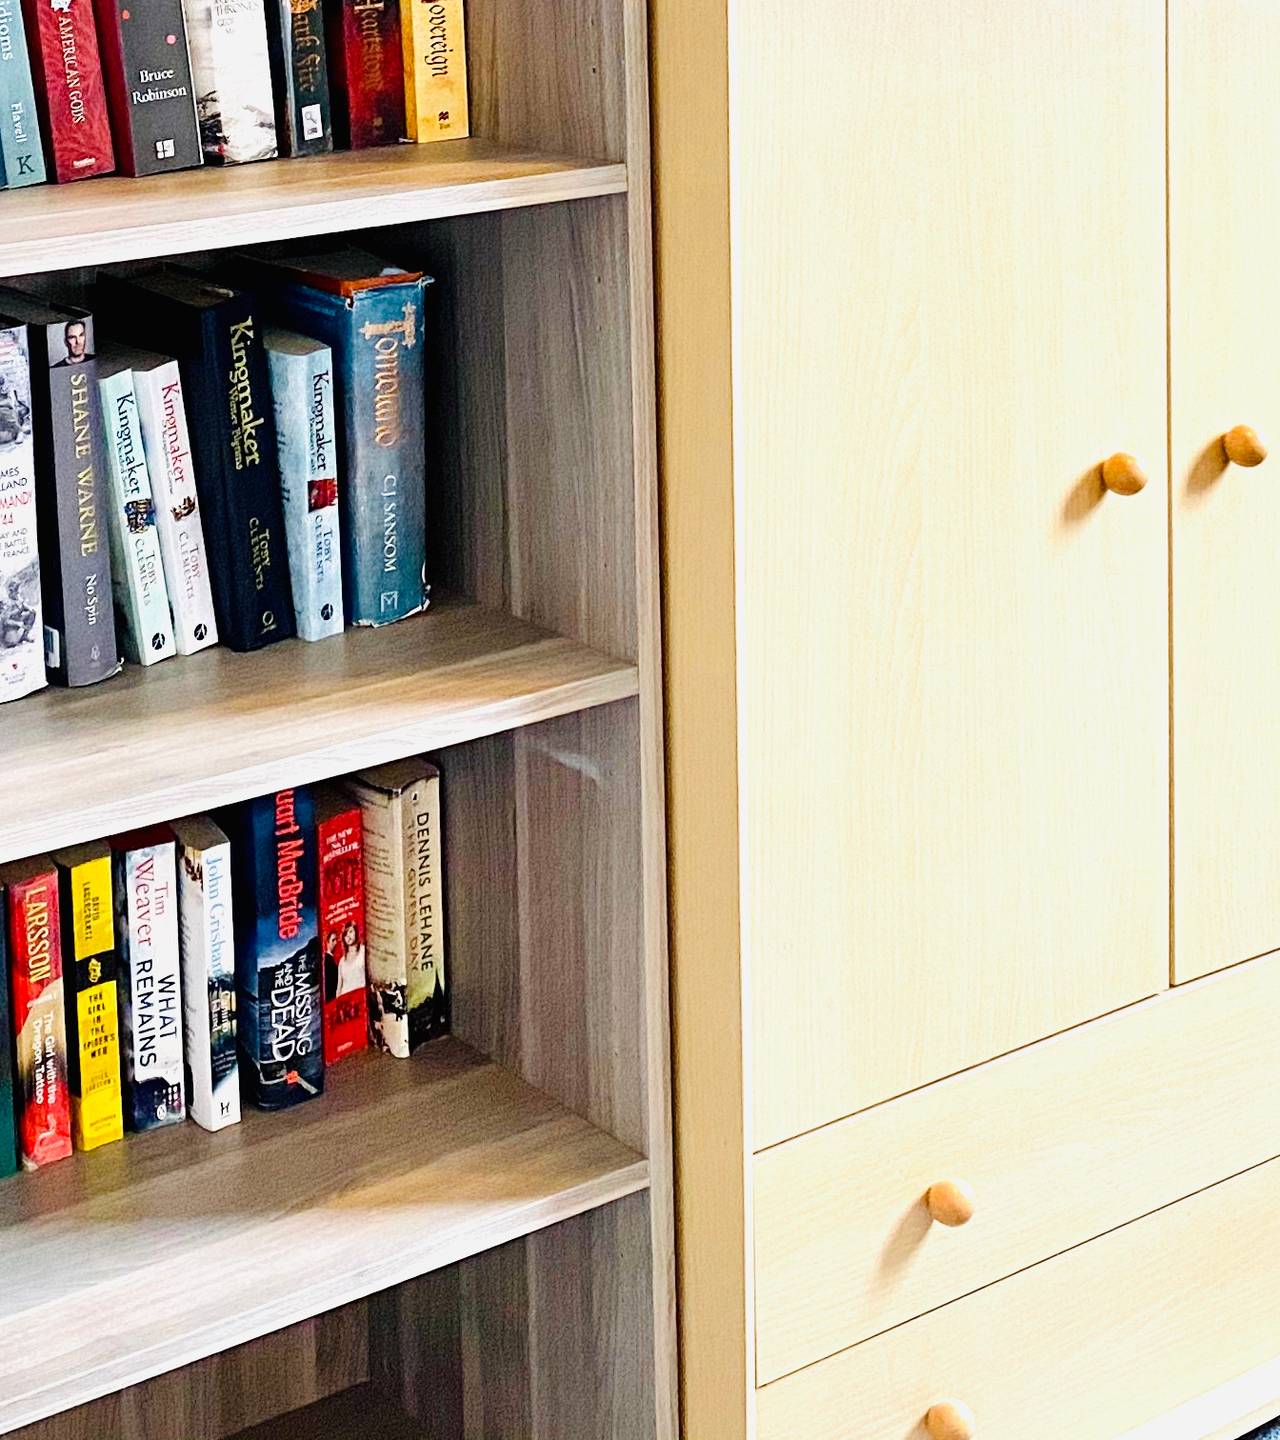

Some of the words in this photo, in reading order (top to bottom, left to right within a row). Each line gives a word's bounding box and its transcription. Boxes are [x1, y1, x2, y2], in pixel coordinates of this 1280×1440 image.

[58, 15, 81, 89] AMERICAN
[132, 86, 188, 105] Robinson
[139, 69, 175, 83] Bruce
[10, 101, 28, 144] Flavell
[68, 90, 86, 125] GODS
[229, 315, 264, 468] Kingmaker
[71, 373, 91, 459] SHANE
[161, 380, 189, 484] Kingmaker
[312, 370, 332, 471] Kingmaker
[116, 391, 144, 495] Kingmaker
[77, 463, 98, 557] WARNE
[383, 502, 397, 572] SANSOM
[85, 574, 97, 595] No
[84, 595, 99, 626] Spin
[416, 812, 431, 887] DENNIS
[154, 881, 169, 916] Tim
[206, 857, 224, 900] John
[277, 838, 305, 940] MacBride
[135, 855, 154, 947] Weaver
[24, 885, 51, 984] LARSSON
[419, 894, 433, 972] LEHANE
[274, 969, 286, 988] THE
[281, 963, 293, 985] AND
[297, 954, 307, 973] THE
[87, 1002, 106, 1015] GIRL
[89, 991, 104, 1003] THE
[136, 959, 157, 1067] REMAINS
[157, 974, 177, 1039] WHAT
[294, 972, 312, 1056] MISSING
[44, 1011, 55, 1036] The
[91, 1025, 105, 1036] THE
[93, 1015, 102, 1025] IN
[271, 988, 297, 1061] DEAD
[32, 1019, 45, 1065] Dragon
[44, 1036, 56, 1058] Girl
[35, 1066, 47, 1105] Tattoo
[46, 1059, 57, 1085] with
[47, 1085, 58, 1105] the
